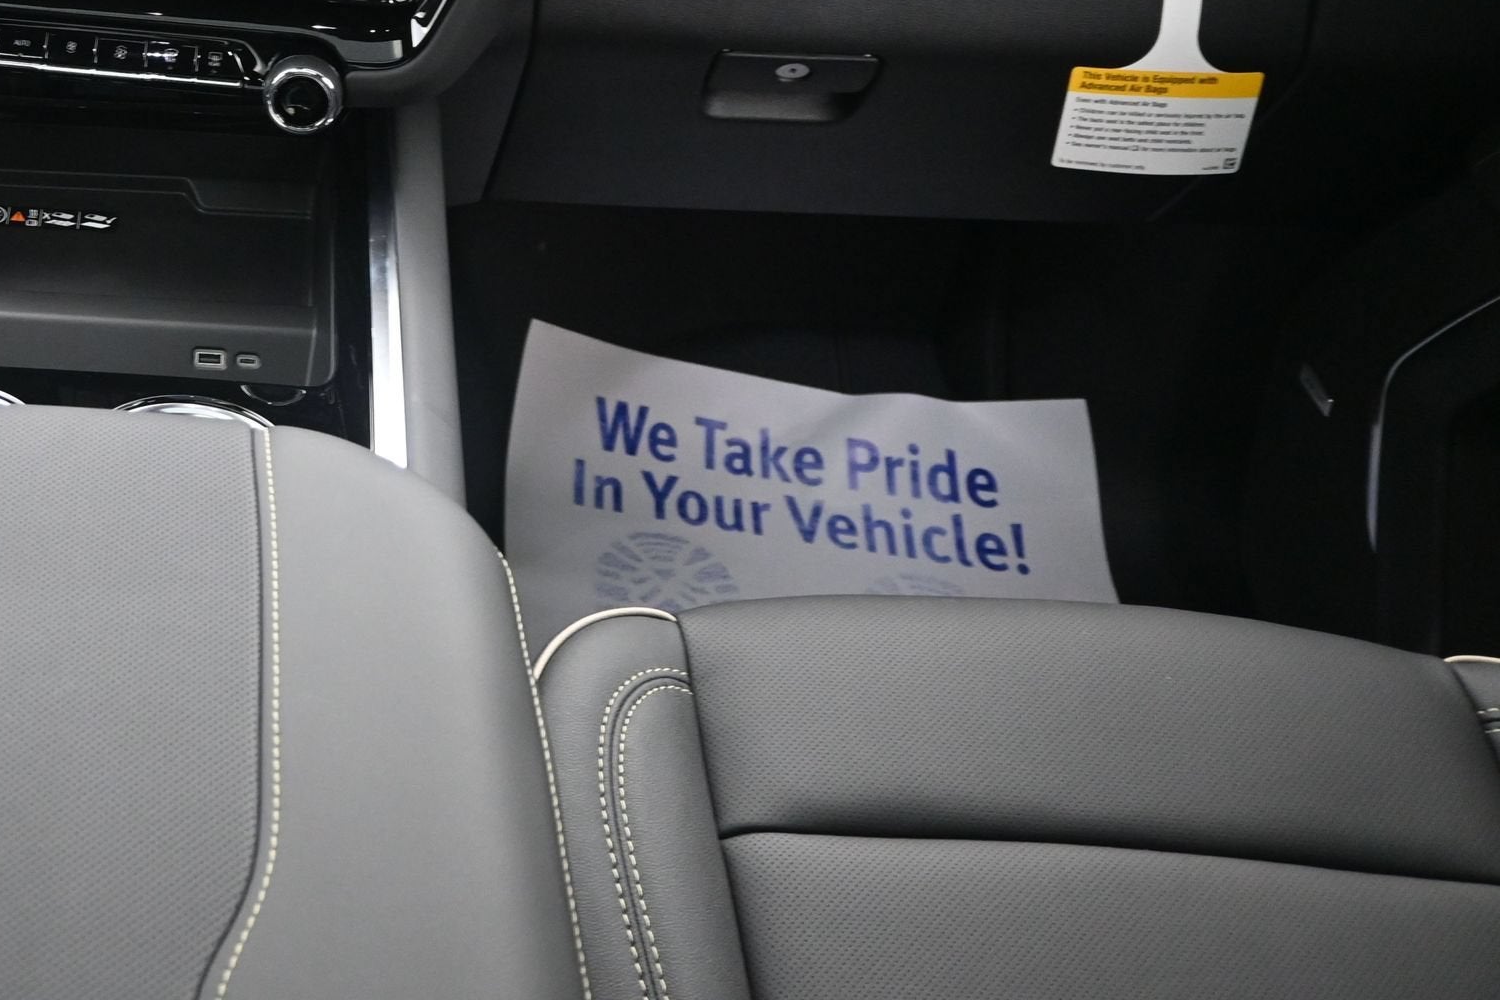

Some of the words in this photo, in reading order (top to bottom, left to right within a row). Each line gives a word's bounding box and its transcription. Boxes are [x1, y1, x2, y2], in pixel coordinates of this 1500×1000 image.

[1079, 81, 1128, 93] Advanced
[1105, 72, 1140, 83] Vehicle
[1152, 74, 1197, 86] Equipped
[596, 396, 678, 462] We
[695, 416, 825, 486] Take
[846, 437, 999, 508] Pride
[572, 459, 624, 512] In
[641, 470, 771, 535] Your
[784, 496, 1032, 576] Vehicle!
